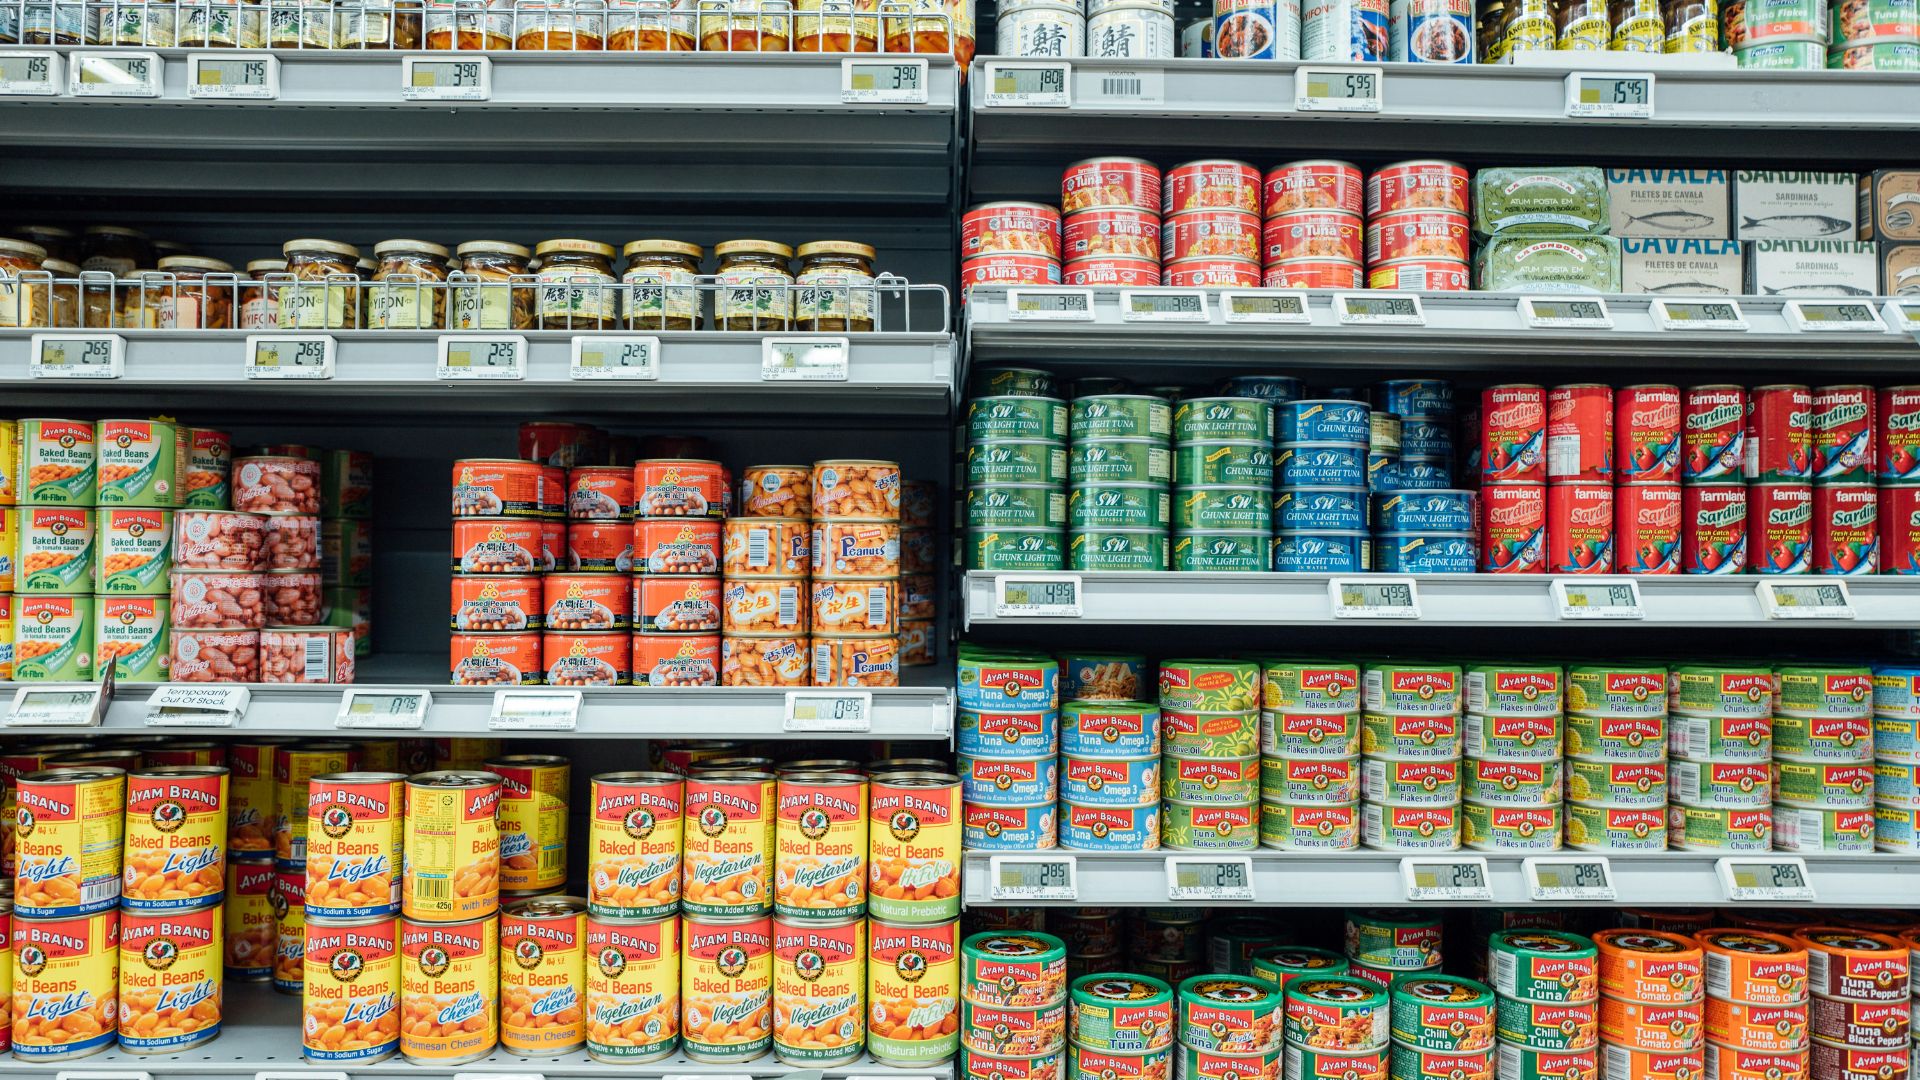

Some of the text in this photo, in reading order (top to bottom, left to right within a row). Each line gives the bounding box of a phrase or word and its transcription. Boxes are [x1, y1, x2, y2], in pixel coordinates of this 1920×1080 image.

[1305, 5, 1329, 22] YIFON
[1751, 7, 1807, 22] Tuna Flakes
[1508, 20, 1537, 37] ANGELO
[1620, 20, 1650, 38] ANGELO
[1751, 47, 1784, 56] FairPrice
[1076, 174, 1103, 187] Tuna
[1284, 176, 1316, 188] Tuna
[1417, 173, 1449, 187] Tuna
[1631, 190, 1659, 199] FILETES
[1674, 191, 1703, 199] CAVALA
[1775, 192, 1818, 201] SARDINHAS
[1001, 217, 1033, 230] Tuna
[1517, 243, 1584, 261] LA GONDOLA
[986, 266, 1018, 279] Tuna
[1795, 262, 1839, 270] SARDINHAS
[283, 297, 315, 309] YIFON
[1689, 393, 1740, 405] farmland
[1687, 404, 1743, 428] Sardines
[43, 427, 92, 440] AYAM BRAND
[1184, 422, 1257, 432] CHUNK LIGHT TUNA
[39, 448, 92, 459] Baked Beans
[1288, 469, 1360, 478] CHUNK LIGHT TUNA
[646, 485, 701, 493] Braised Peanuts
[1493, 488, 1540, 500] farmland
[41, 493, 67, 502] Hi-Fibre
[1076, 509, 1146, 518] CHUNK LIGHT TUNA
[1490, 501, 1543, 522] Sardines
[841, 536, 884, 557] Peanuts
[852, 652, 893, 673] Peanuts
[984, 671, 1040, 686] AYAM BRAND
[166, 688, 231, 698] Temporarily
[980, 690, 1049, 702] Tuna Omega 3
[197, 697, 226, 705] Stock
[1281, 735, 1302, 744] Tuna
[1287, 745, 1308, 753] Flakes
[1310, 745, 1316, 753] in
[1320, 746, 1336, 754] Olive
[1184, 763, 1237, 778] AYAM BRAND
[1180, 782, 1201, 791] Tuna
[129, 785, 217, 806] AYAM BRAND
[1180, 792, 1243, 801] Flakes in Olive Oil
[908, 796, 948, 818] BRAND
[1291, 828, 1312, 838] Tuna
[129, 834, 211, 848] Baked Beans
[1294, 838, 1319, 846] Chunks
[872, 842, 944, 858] Baked Beans
[162, 847, 221, 874] Light
[1040, 864, 1064, 886] 285
[1216, 864, 1241, 886] 285
[151, 899, 174, 907] Sodium
[186, 898, 202, 906] Sugar
[436, 900, 452, 911] 425g
[307, 934, 394, 952] AYAM BRAND
[977, 982, 998, 993] Chilli
[1635, 981, 1668, 993] Tuna
[1840, 976, 1874, 988] Tuna
[974, 991, 1002, 1003] Tuna
[1635, 990, 1692, 1002] Tomato Chilli
[1841, 986, 1899, 1000] Black Pepper
[457, 993, 480, 1008] With
[438, 1000, 483, 1023] Cheese
[791, 993, 858, 1028] Vegetarian
[1427, 1010, 1483, 1024] AYAM BRAND
[1424, 1028, 1448, 1040] Chilli
[408, 1037, 482, 1051] Parmesan Cheese
[886, 1042, 952, 1056] Natural Prebiotic
[1418, 1036, 1452, 1050] Tuna
